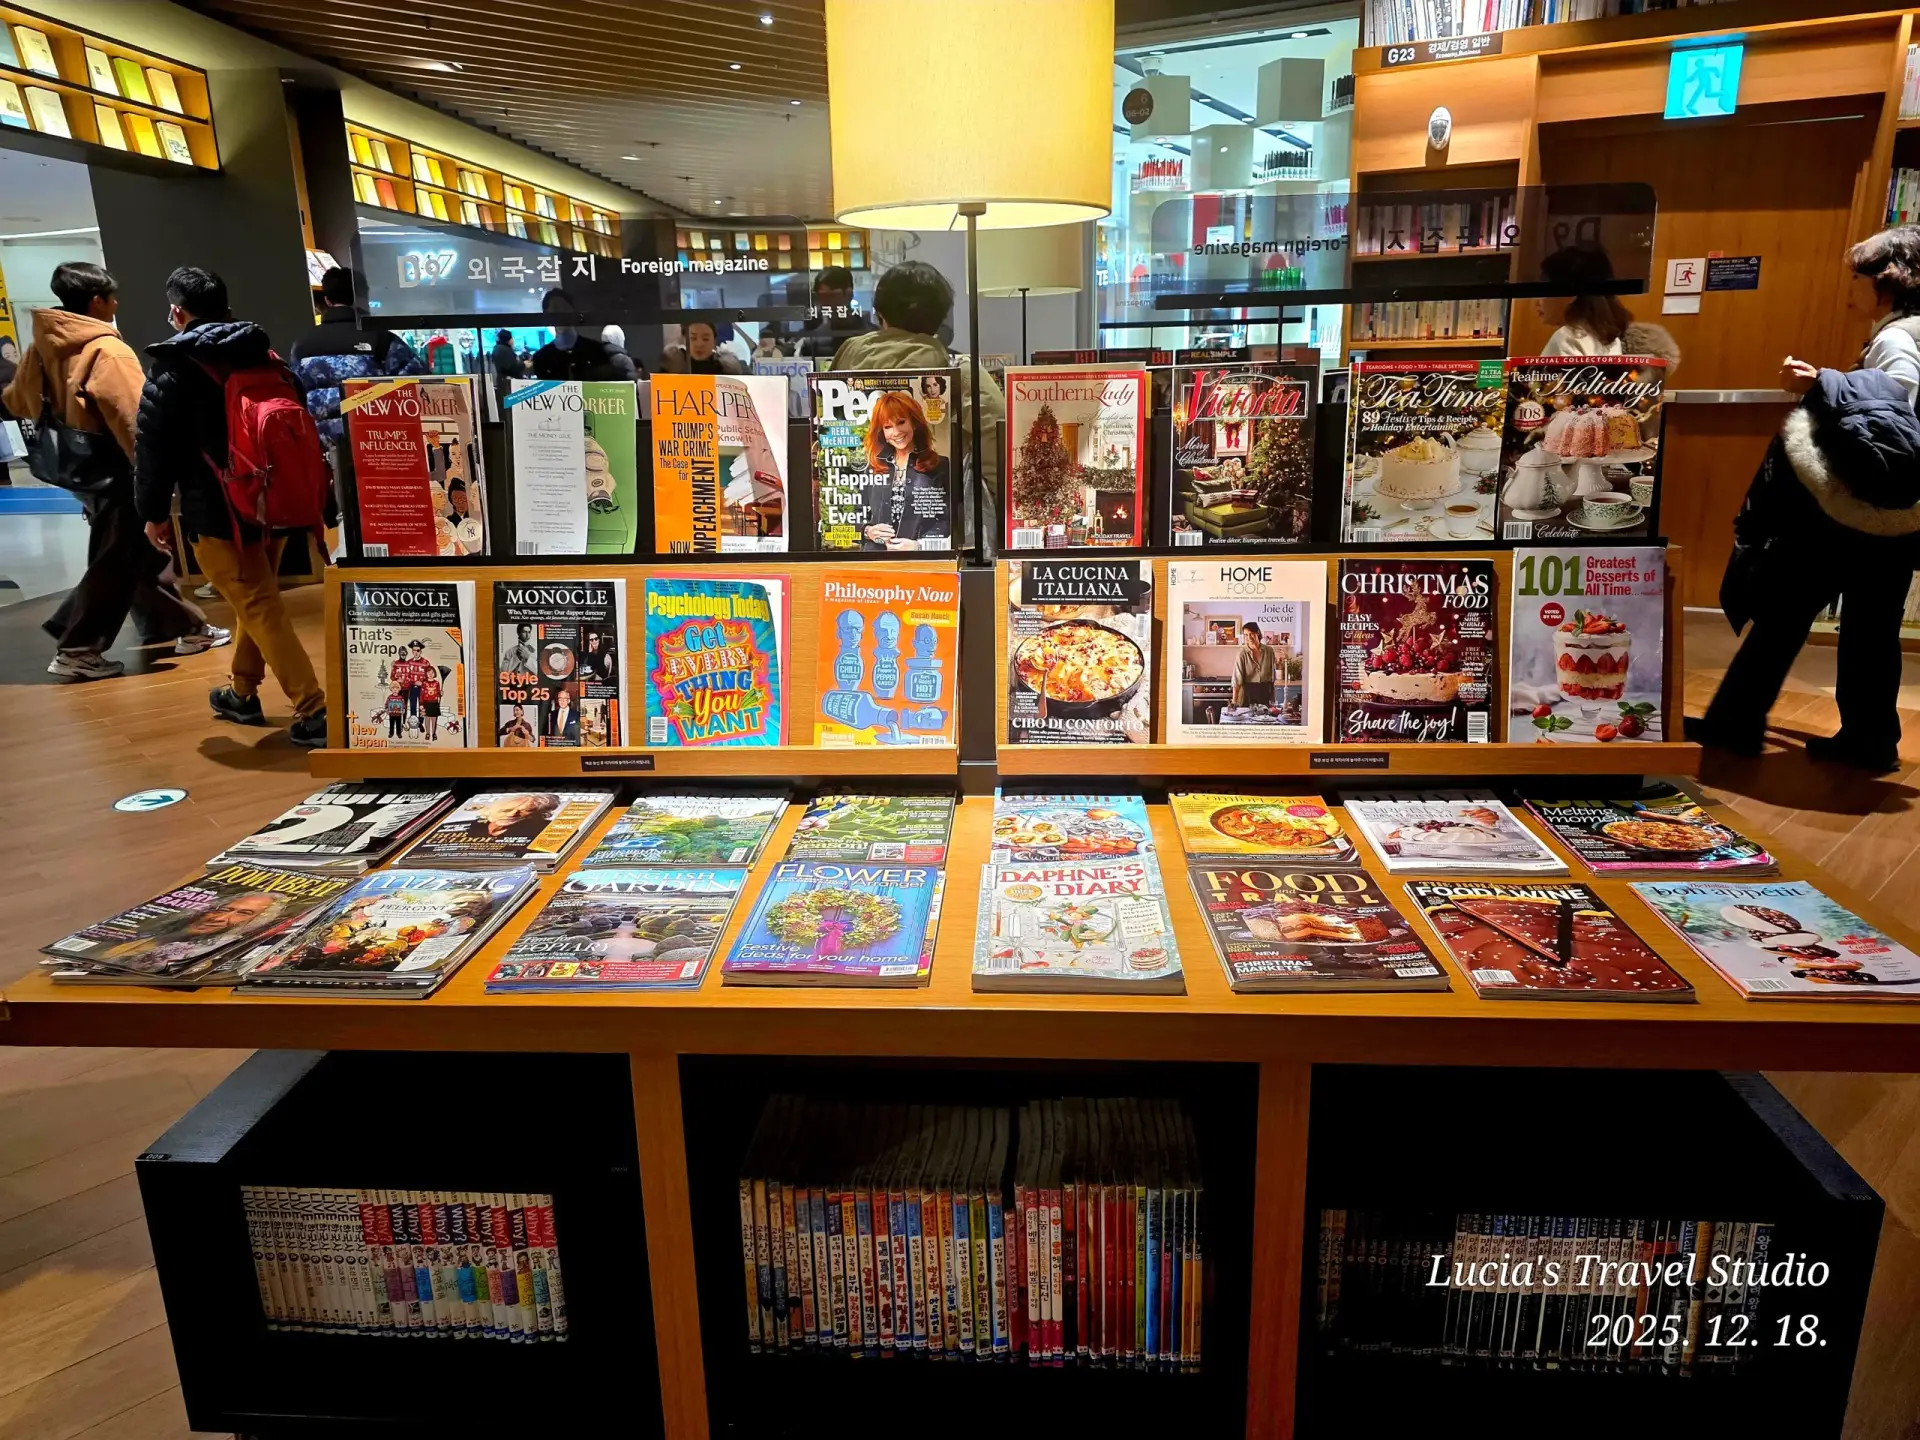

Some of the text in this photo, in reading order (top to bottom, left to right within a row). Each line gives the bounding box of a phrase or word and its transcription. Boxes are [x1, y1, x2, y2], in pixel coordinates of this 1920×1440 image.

[1471, 36, 1491, 47] 일반
[1388, 48, 1416, 63] G23
[467, 253, 769, 284] 외국잡지 Foreign magazine
[396, 390, 413, 398] THE
[562, 385, 578, 393] THE
[1015, 380, 1135, 407] Southern Lady
[1536, 366, 1663, 409] Holidays
[1188, 369, 1302, 426] Victoria
[356, 398, 461, 416] NEW YORKER
[521, 394, 627, 416] NEW YORKER
[1362, 411, 1381, 424] 89
[1419, 415, 1436, 423] Tips
[1446, 415, 1478, 424] Recipes
[1518, 408, 1541, 420] 108
[672, 422, 714, 440] TRUMP'S
[717, 424, 743, 433] Public
[831, 428, 850, 436] REBA
[1370, 423, 1459, 433] Holiday Entertaining
[366, 431, 407, 441] TRUMP'S
[746, 435, 753, 443] It
[822, 436, 860, 446] McENTIRE
[360, 441, 417, 451] INFLUENCER
[659, 440, 715, 458] WAR CRIME:
[1176, 436, 1210, 453] Merry
[660, 458, 689, 469] The Case
[1175, 451, 1220, 467] Christmas
[678, 470, 689, 481] for
[827, 468, 890, 490] Happier
[822, 487, 862, 505] Than
[1534, 524, 1579, 540] Celebrate
[1208, 536, 1225, 544] Festive
[1586, 556, 1637, 569] Greatest
[1032, 567, 1130, 580] LA CUCINA
[1220, 567, 1272, 581] HOME
[1518, 555, 1584, 596] 101
[1585, 569, 1656, 582] Desserts of
[1037, 582, 1124, 596] ITALIANA
[1227, 582, 1267, 594] FOOD
[1341, 573, 1489, 595] CHRISTMAS
[1585, 583, 1600, 596] All
[353, 591, 450, 607] MONOCLE
[505, 590, 608, 605] MONOCLE
[824, 582, 954, 605] Philosophy Now
[648, 591, 770, 622] Psychology Today
[1262, 603, 1294, 614] Joie de
[1442, 595, 1489, 609] FOOD
[361, 610, 386, 618] foresight,
[507, 608, 522, 616] Who,
[522, 608, 538, 616] What,
[565, 609, 584, 617] dapper
[584, 609, 606, 617] directory
[1257, 614, 1294, 623] recevoir
[1347, 613, 1372, 622] EASY
[1340, 622, 1380, 631] RECIPES
[349, 627, 392, 641] That's
[684, 621, 727, 652] Get
[1344, 631, 1375, 639] & ideas
[349, 642, 398, 657] a Wrap
[667, 646, 752, 678] EVERY
[840, 665, 860, 673] CHILLI
[499, 671, 538, 687] Style
[674, 670, 753, 702] THING
[499, 687, 550, 702] Top 25
[916, 684, 933, 693] HOT
[694, 687, 744, 726] You
[351, 724, 377, 736] New
[681, 706, 762, 740] WANT
[1012, 718, 1144, 731] CIBO DI CONFORTO
[1349, 706, 1458, 743] Share the joy!
[353, 736, 388, 748] Japan
[1542, 806, 1617, 817] Melting
[1546, 814, 1643, 823] moments
[608, 872, 715, 880] ENGLISH
[776, 863, 927, 883] FLOWER
[1000, 863, 1144, 883] DAPHNE'S
[209, 865, 348, 897] DOWNBEAT
[561, 877, 736, 894] GARDEN
[851, 878, 926, 889] Arranger
[1053, 879, 1147, 896] DIARY
[1199, 870, 1368, 893] FOOD
[1211, 892, 1380, 905] TRAVEL
[1651, 886, 1704, 897] bon
[740, 943, 800, 952] Festive
[736, 950, 909, 964] ideas for your home
[1233, 960, 1313, 968] CHRISTMAS
[1235, 965, 1304, 973] MARKETS
[392, 1206, 408, 1242] Why?
[452, 1207, 467, 1242] Why?
[481, 1209, 496, 1244] Why?
[543, 1209, 557, 1244] Why?
